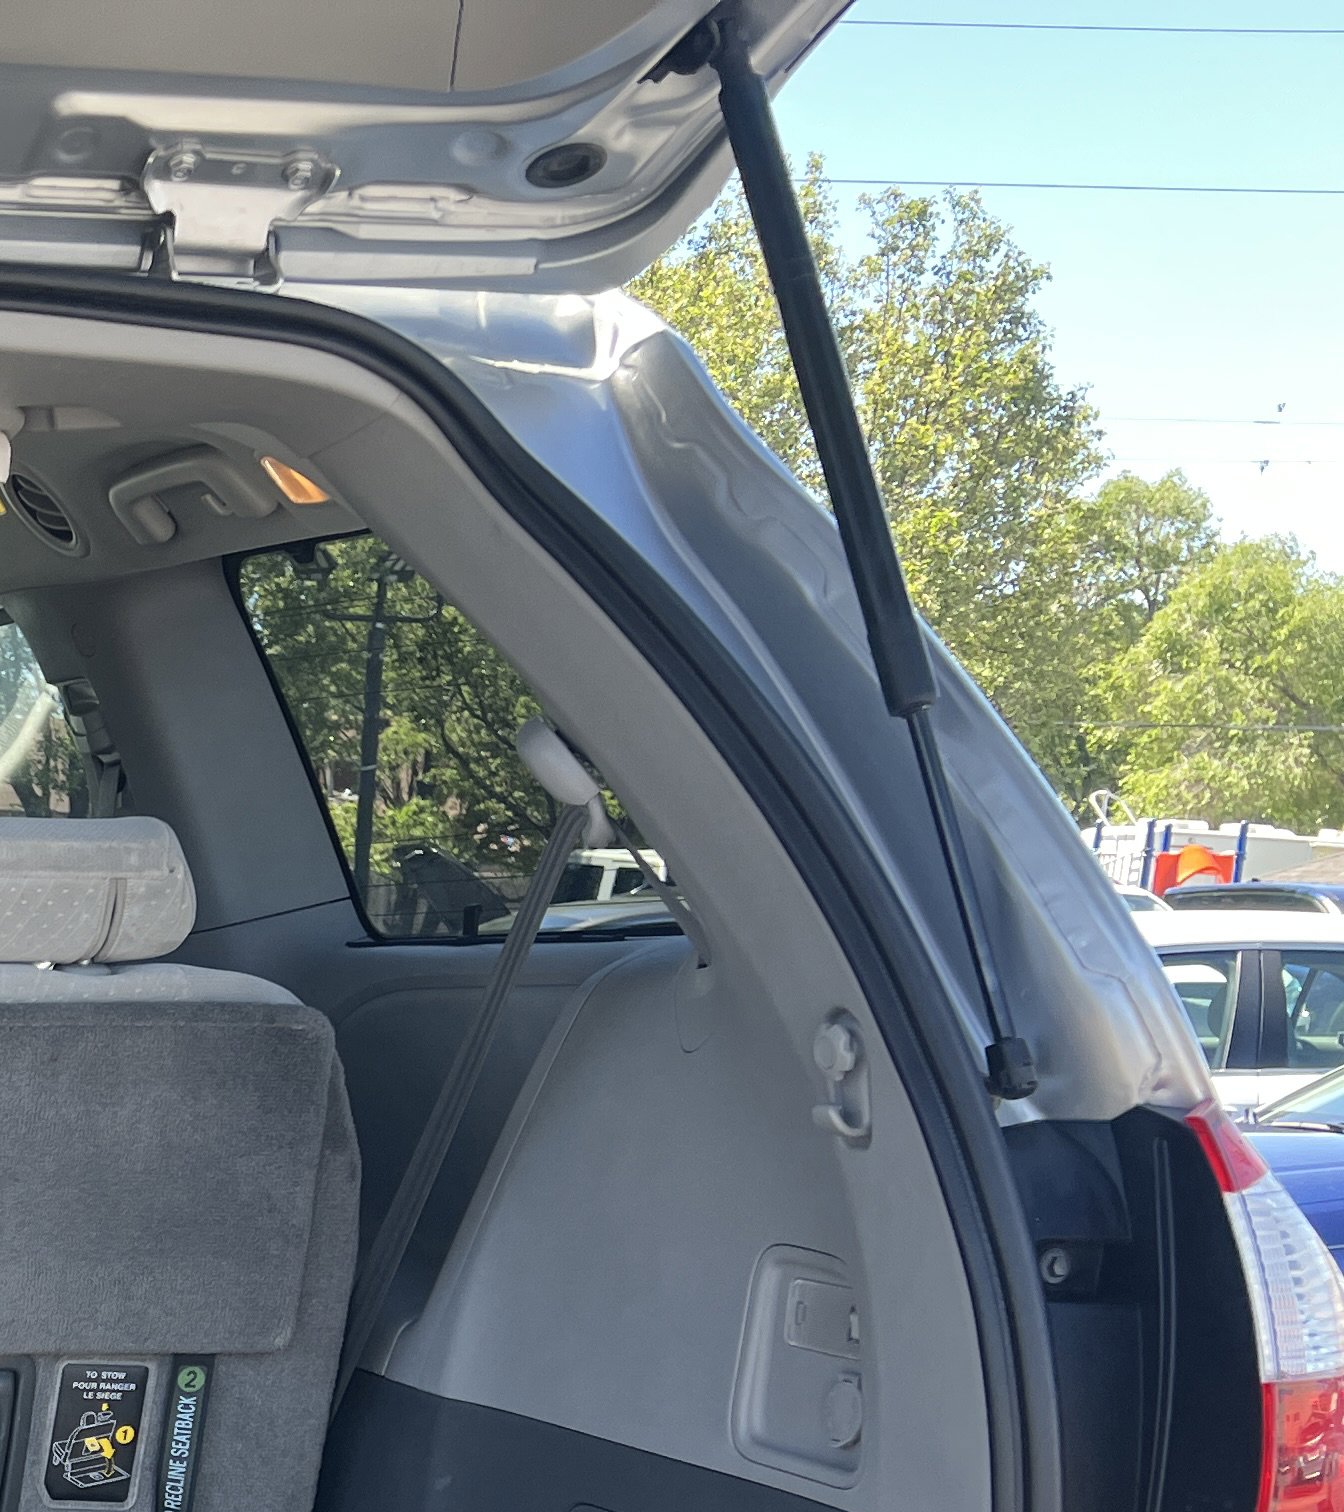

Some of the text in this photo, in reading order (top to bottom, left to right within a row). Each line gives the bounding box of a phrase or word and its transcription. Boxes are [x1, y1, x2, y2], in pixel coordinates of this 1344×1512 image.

[86, 1370, 127, 1380] TO STOW
[184, 1370, 198, 1389] 2
[72, 1381, 136, 1391] POUR RANGER
[83, 1391, 94, 1400] LE
[170, 1395, 197, 1458] SEATBACK
[121, 1428, 129, 1441] 1
[164, 1459, 187, 1510] RECLINE
